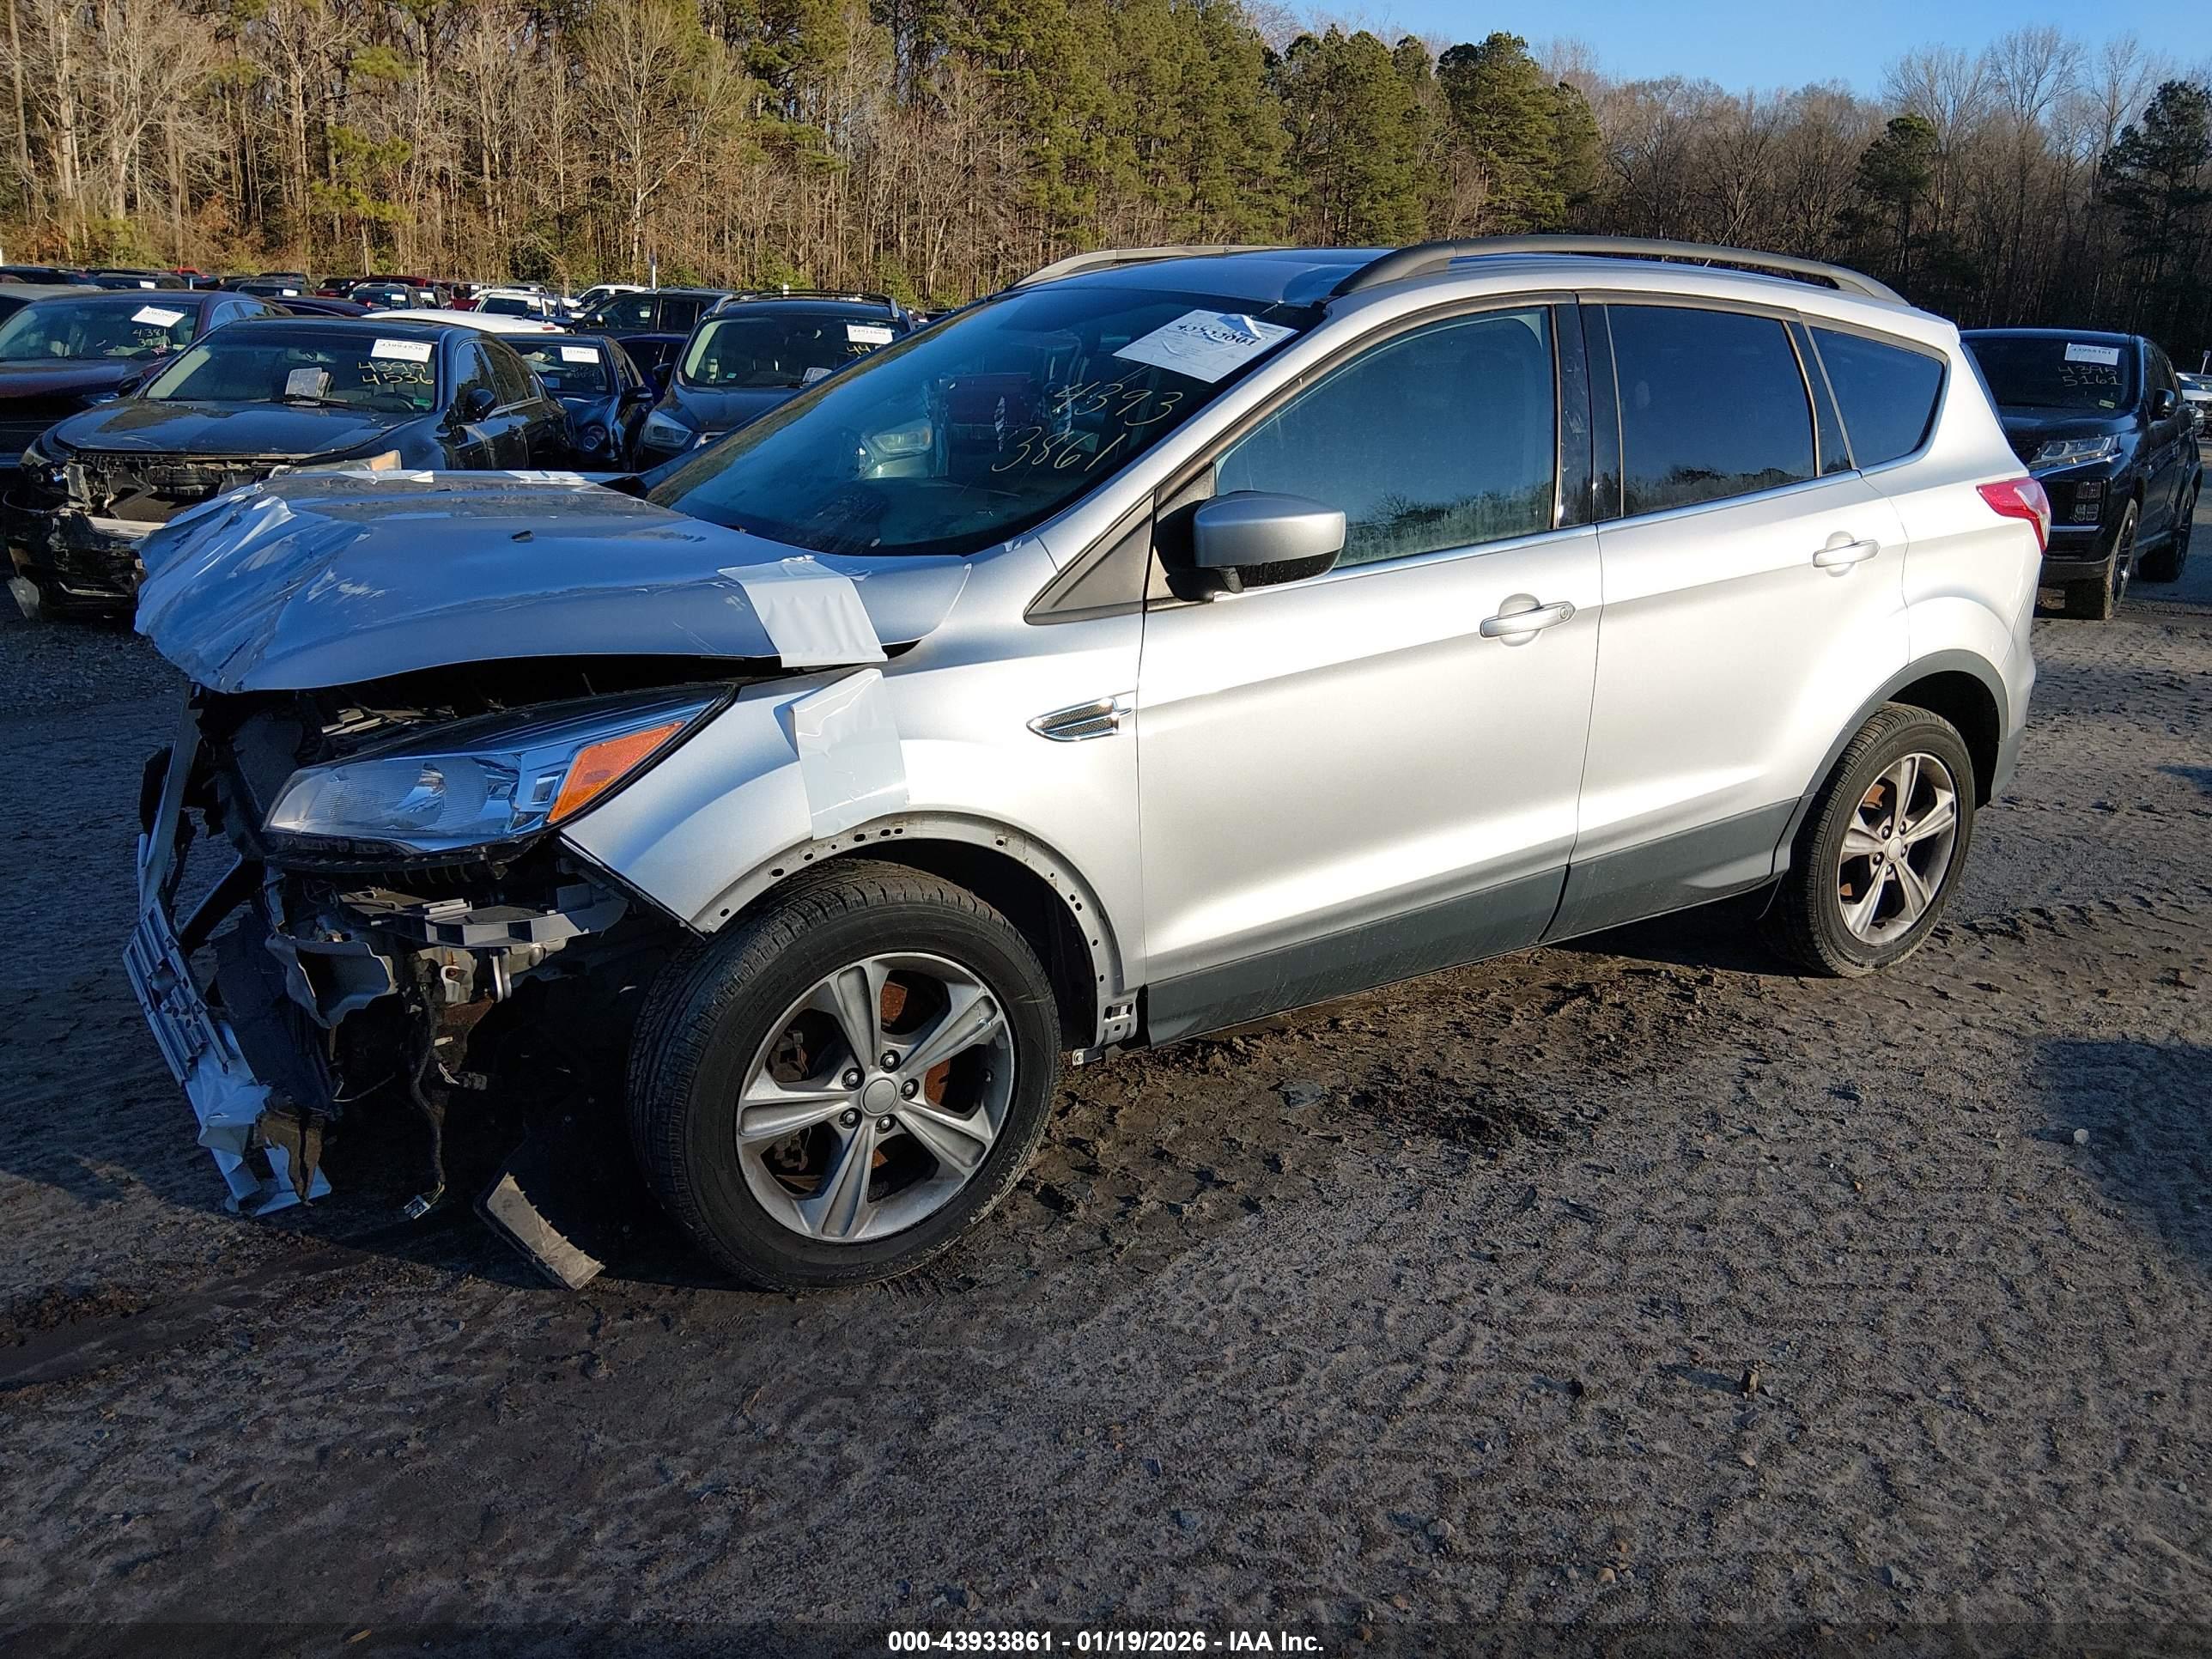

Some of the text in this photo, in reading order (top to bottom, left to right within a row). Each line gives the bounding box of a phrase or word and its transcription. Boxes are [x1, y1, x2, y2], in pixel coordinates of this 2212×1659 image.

[358, 361, 426, 374] 4399
[2057, 365, 2118, 375] 4395
[362, 372, 434, 386] 4536
[2062, 374, 2123, 387] 5161
[1051, 380, 1184, 427] 4393
[991, 426, 1127, 472] 3861
